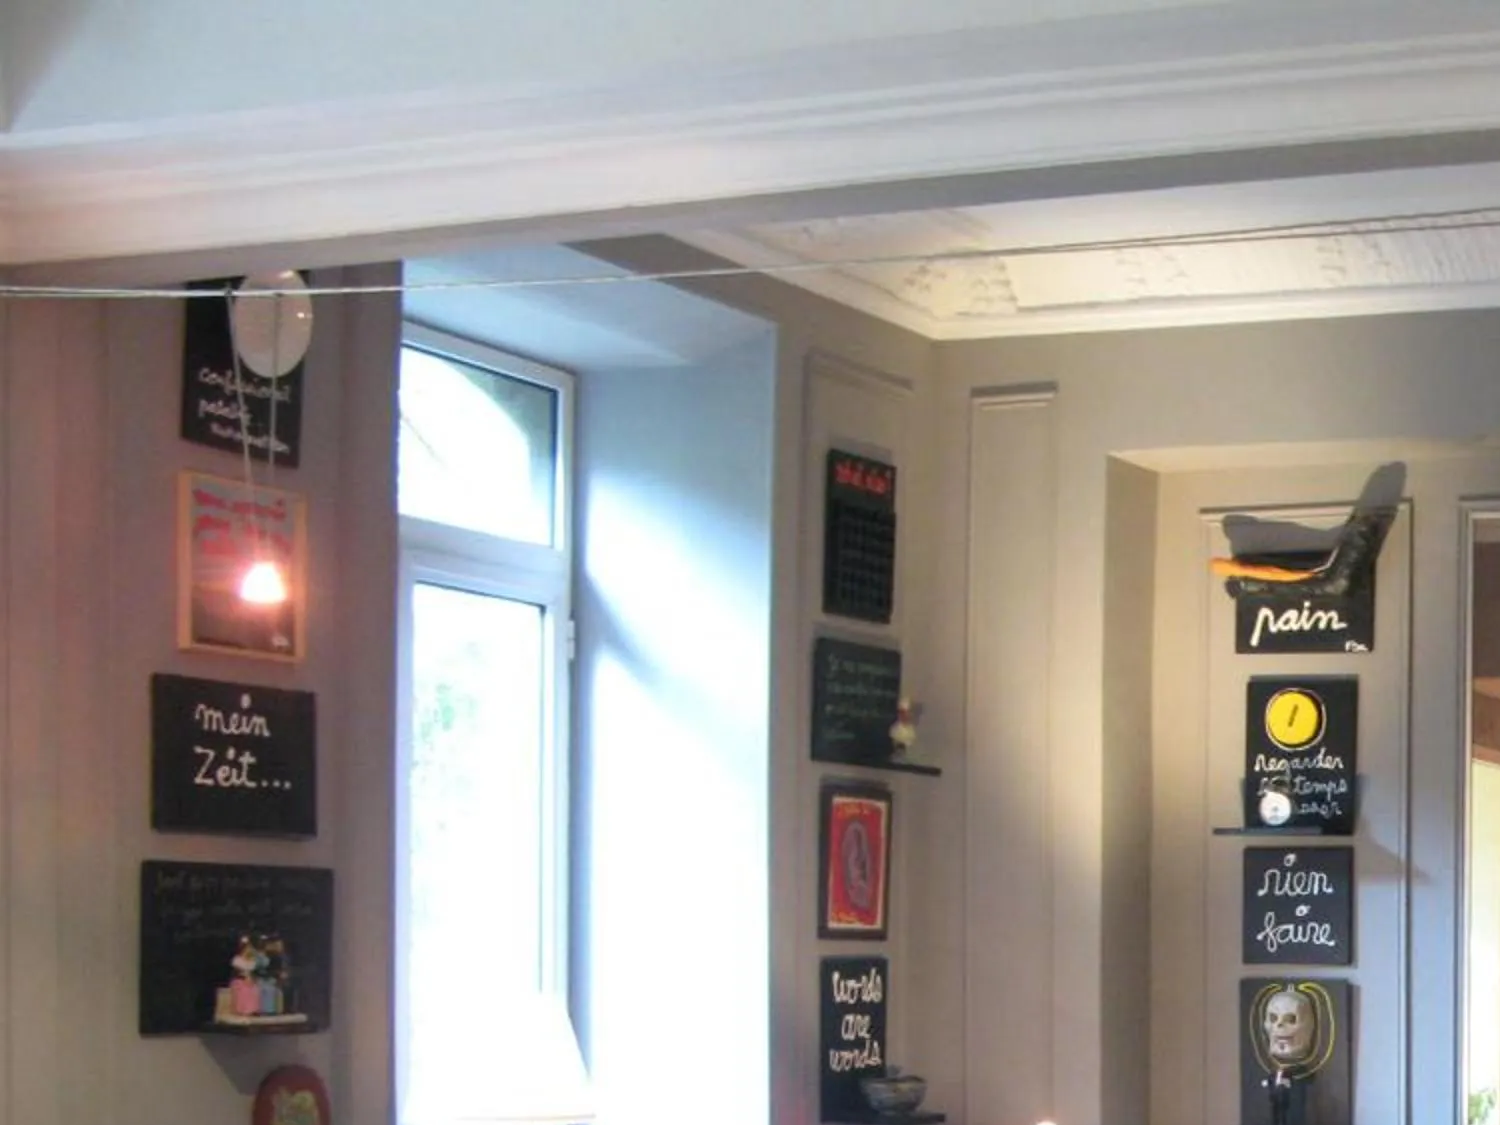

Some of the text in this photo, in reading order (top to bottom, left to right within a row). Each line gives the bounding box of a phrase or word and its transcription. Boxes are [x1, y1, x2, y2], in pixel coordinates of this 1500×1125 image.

[1250, 599, 1348, 647] pain
[194, 692, 271, 738] mein
[1253, 746, 1345, 780] regarder
[1257, 853, 1334, 897] rien
[1256, 904, 1336, 953] faire
[841, 1014, 872, 1041] are
[829, 1039, 883, 1073] words
